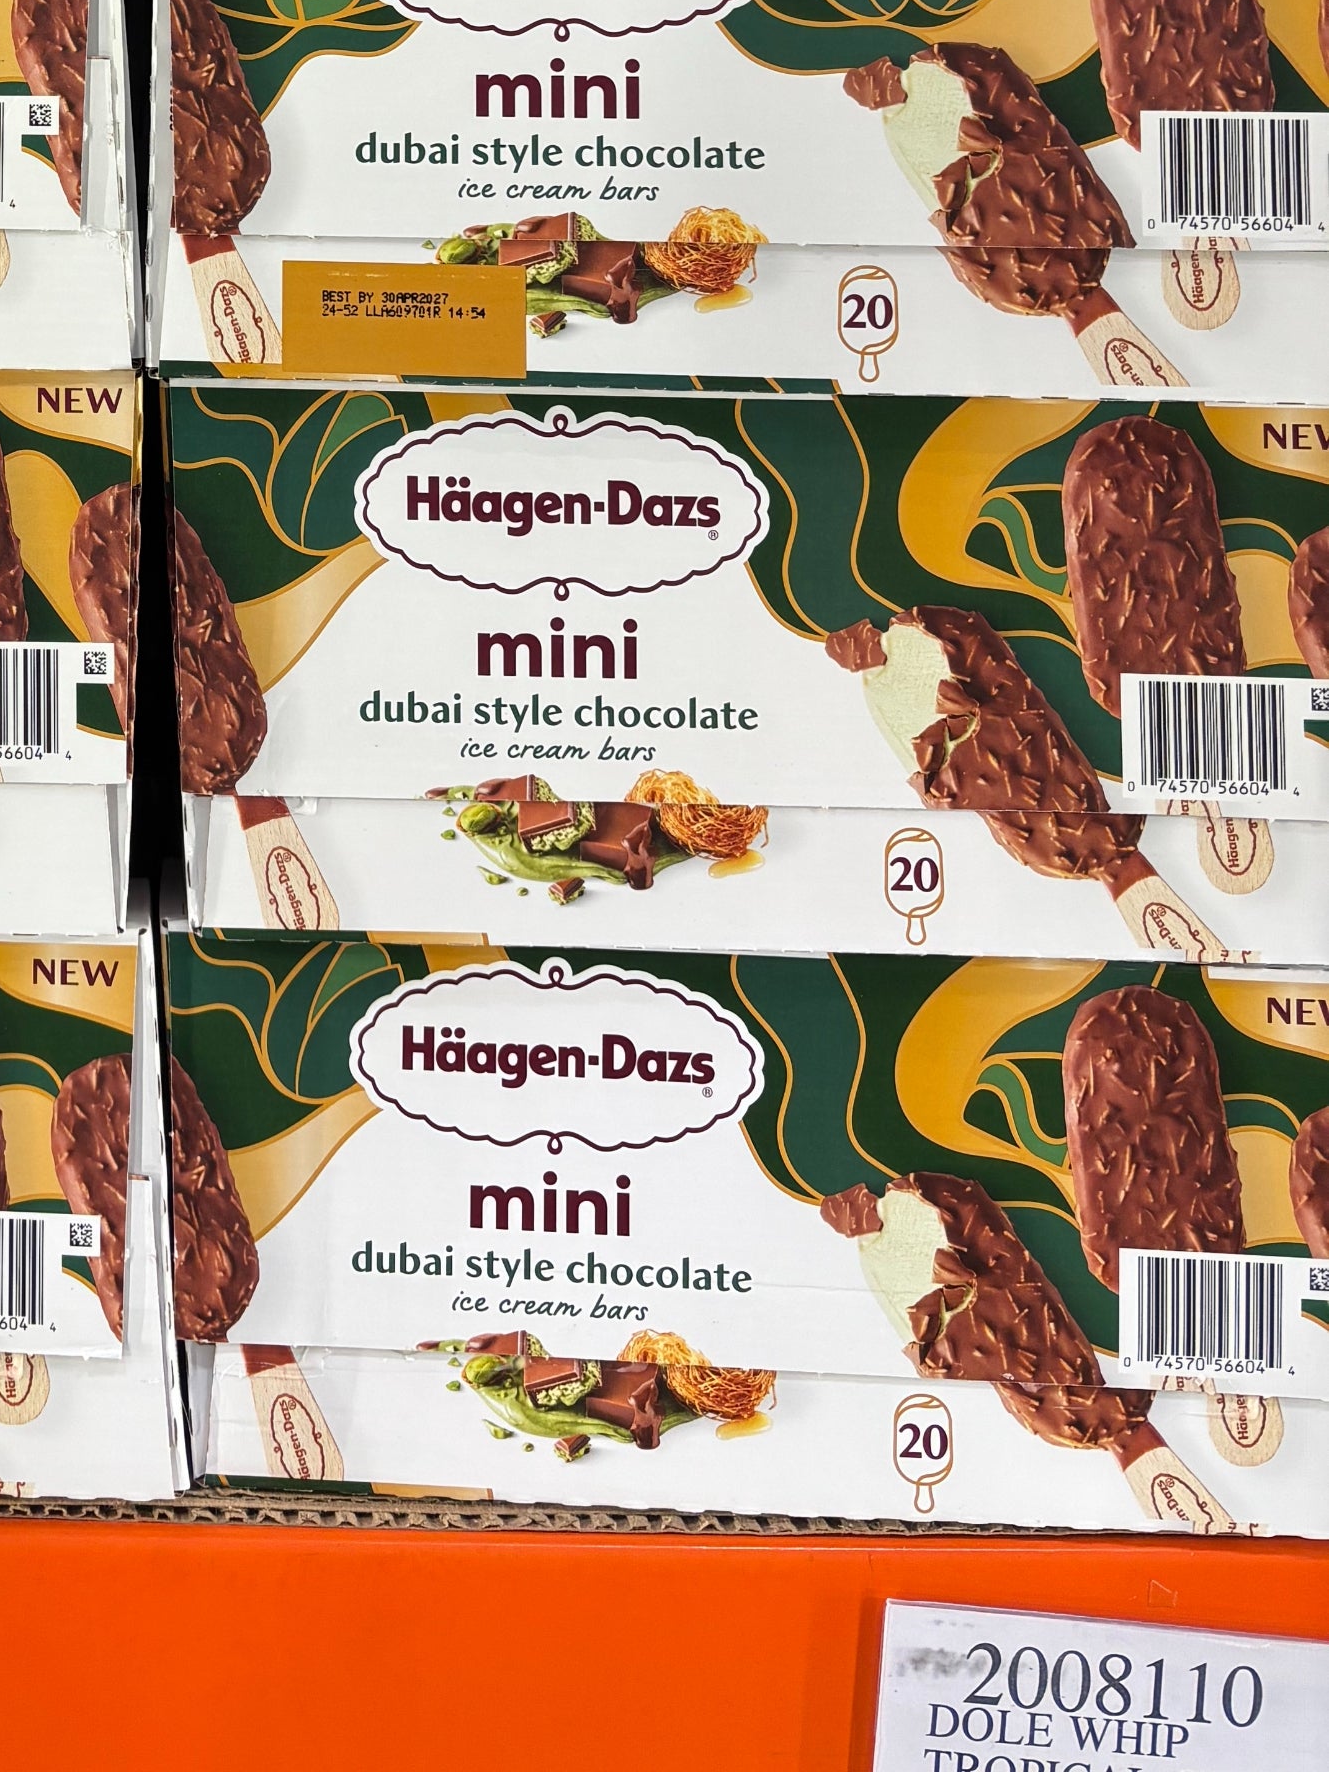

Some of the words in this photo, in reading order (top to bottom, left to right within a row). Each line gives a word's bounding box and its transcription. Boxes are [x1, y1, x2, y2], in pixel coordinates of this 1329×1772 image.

[476, 58, 640, 119] mini
[356, 132, 458, 164] dubai
[472, 134, 562, 173] style
[575, 135, 765, 169] chocolate
[458, 178, 496, 198] ice
[506, 185, 591, 199] cream
[599, 176, 659, 201] bars
[1179, 217, 1231, 230] 74570
[1240, 218, 1293, 231] 56604
[321, 304, 359, 317] 24-52
[448, 306, 486, 319] 14:54
[322, 290, 352, 303] BEST
[358, 291, 374, 303] BY
[382, 292, 449, 305] 30APR2027
[843, 294, 893, 329] 20
[38, 387, 122, 413] NEW
[407, 476, 720, 537] Häagen-Dazs
[478, 617, 637, 679] mini
[360, 690, 461, 723] dubai
[474, 694, 562, 733] style
[575, 695, 758, 730] chocolate
[461, 738, 497, 758] ice
[508, 744, 590, 759] cream
[598, 736, 656, 761] bars
[1158, 779, 1210, 794] 74570
[1218, 781, 1270, 796] 56604
[890, 857, 939, 892] 20
[33, 958, 119, 987] NEW
[402, 1025, 715, 1088] Häagen-Dazs
[470, 1171, 630, 1236] mini
[352, 1241, 453, 1276] dubai
[466, 1248, 554, 1287] style
[567, 1252, 752, 1292] chocolate
[452, 1291, 489, 1312] ice
[499, 1299, 582, 1317] cream
[590, 1294, 648, 1321] bars
[1154, 1357, 1206, 1371] 74570
[1214, 1359, 1266, 1374] 56604
[899, 1423, 948, 1460] 20
[963, 1643, 1264, 1727] 2008110
[926, 1703, 1053, 1748] DOLE
[1069, 1716, 1189, 1758] WHIP
